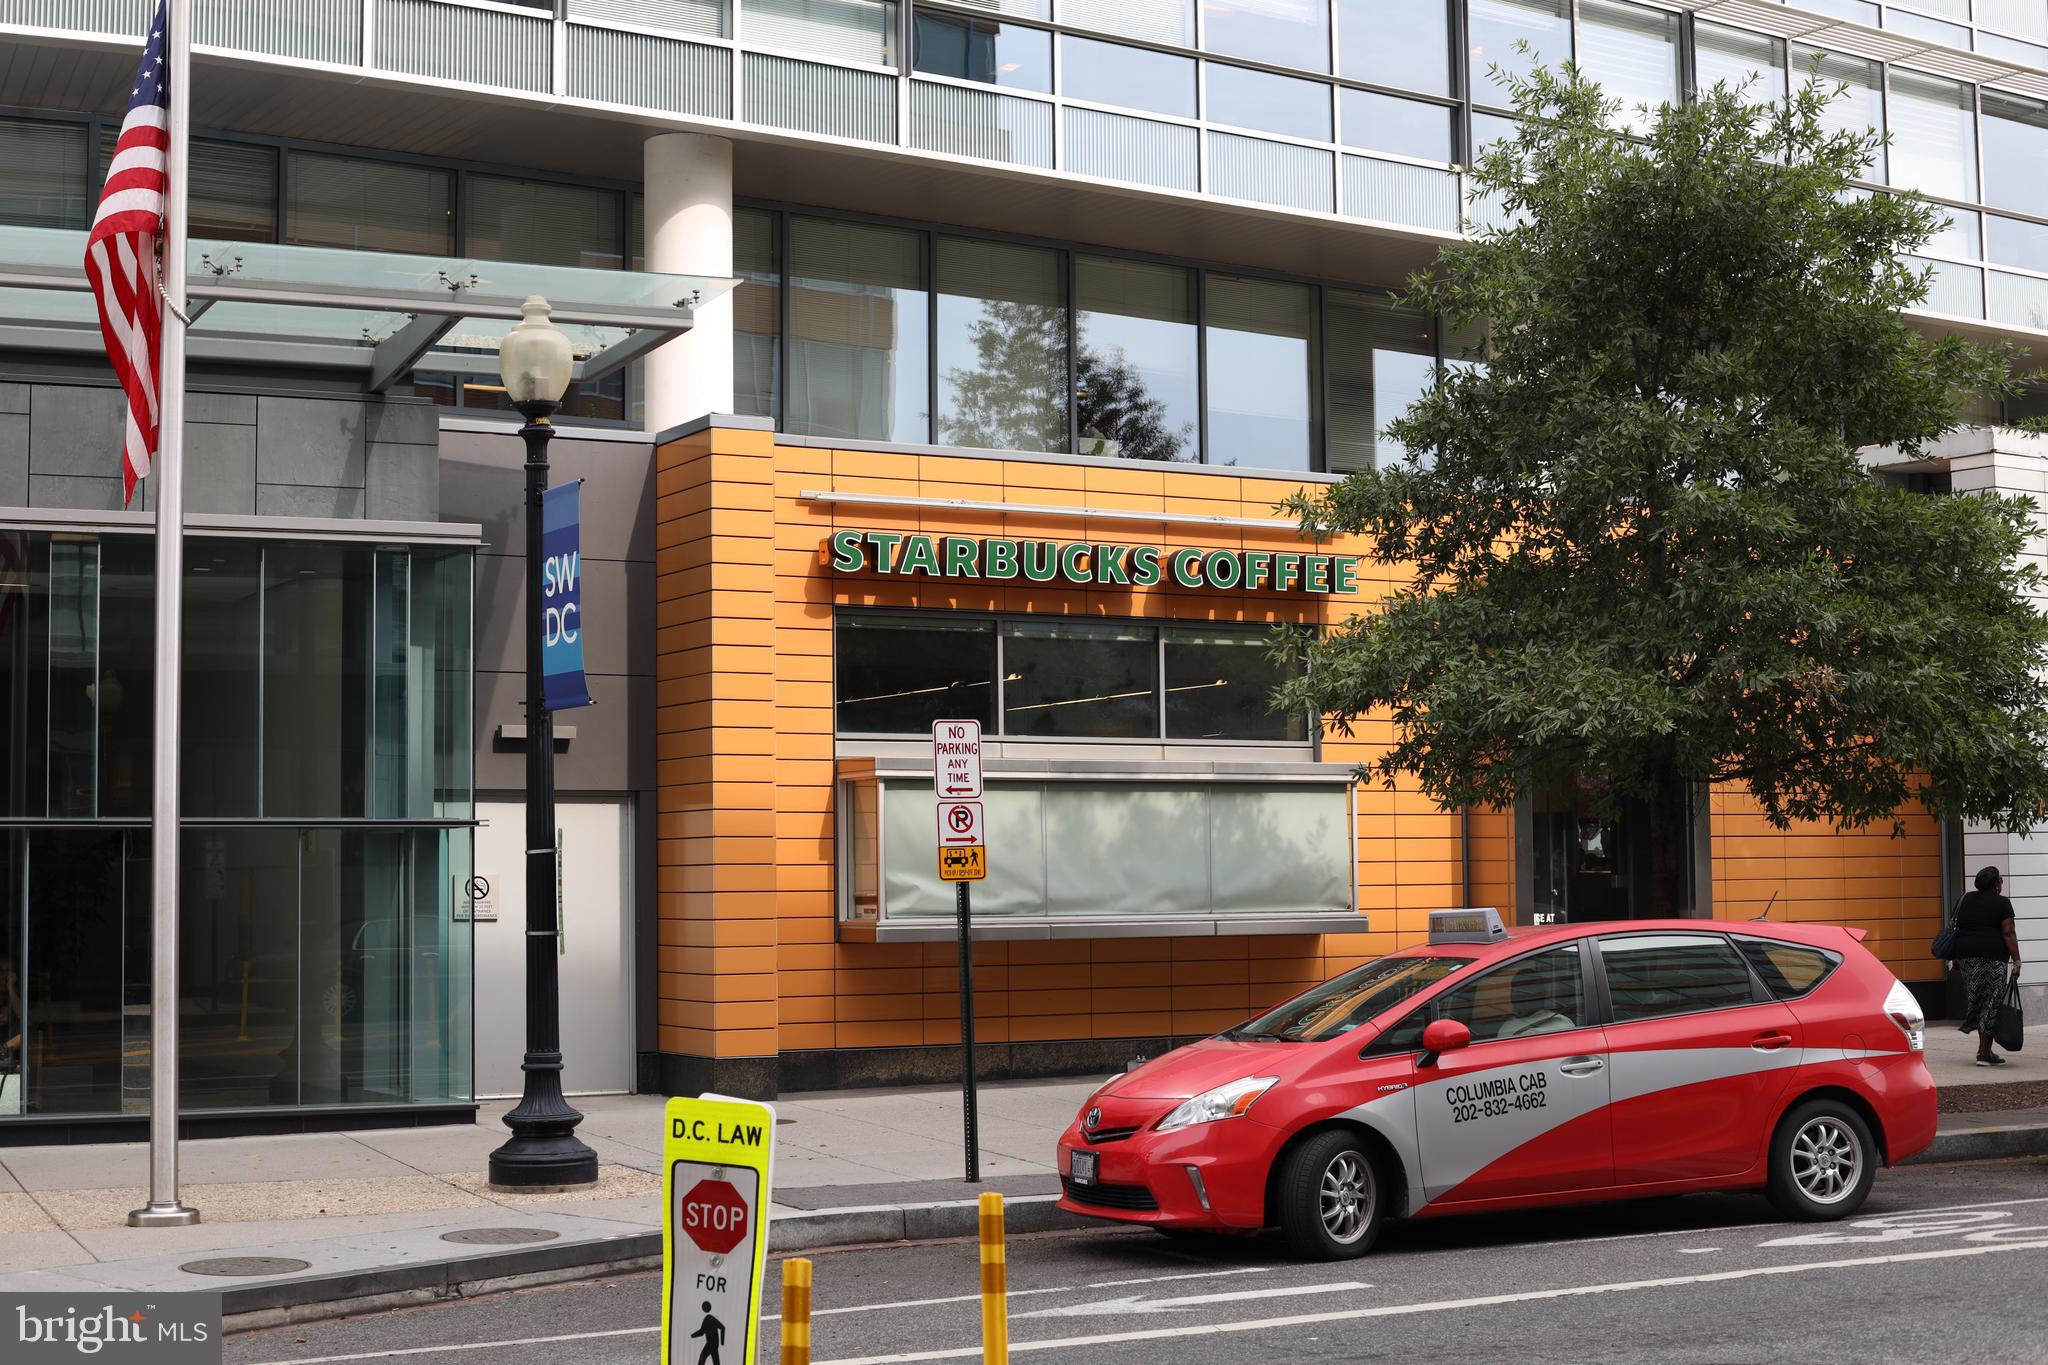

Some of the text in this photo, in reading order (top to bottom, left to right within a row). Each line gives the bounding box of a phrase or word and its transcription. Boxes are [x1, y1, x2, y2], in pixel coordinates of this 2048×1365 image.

[545, 551, 577, 598] SW
[832, 529, 1359, 594] STARBUCKS COFFEE
[546, 602, 578, 647] DC
[948, 726, 965, 739] NO
[937, 742, 978, 755] PARKING
[947, 758, 968, 769] ANY
[947, 772, 970, 783] TIME
[1377, 1083, 1403, 1092] HYBRID
[1446, 1072, 1547, 1105] COLUMBIA CAB
[1453, 1091, 1547, 1123] 202-832-4662
[672, 1118, 762, 1147] D.C. LAW
[686, 1201, 744, 1232] STOP
[696, 1273, 727, 1293] FOR
